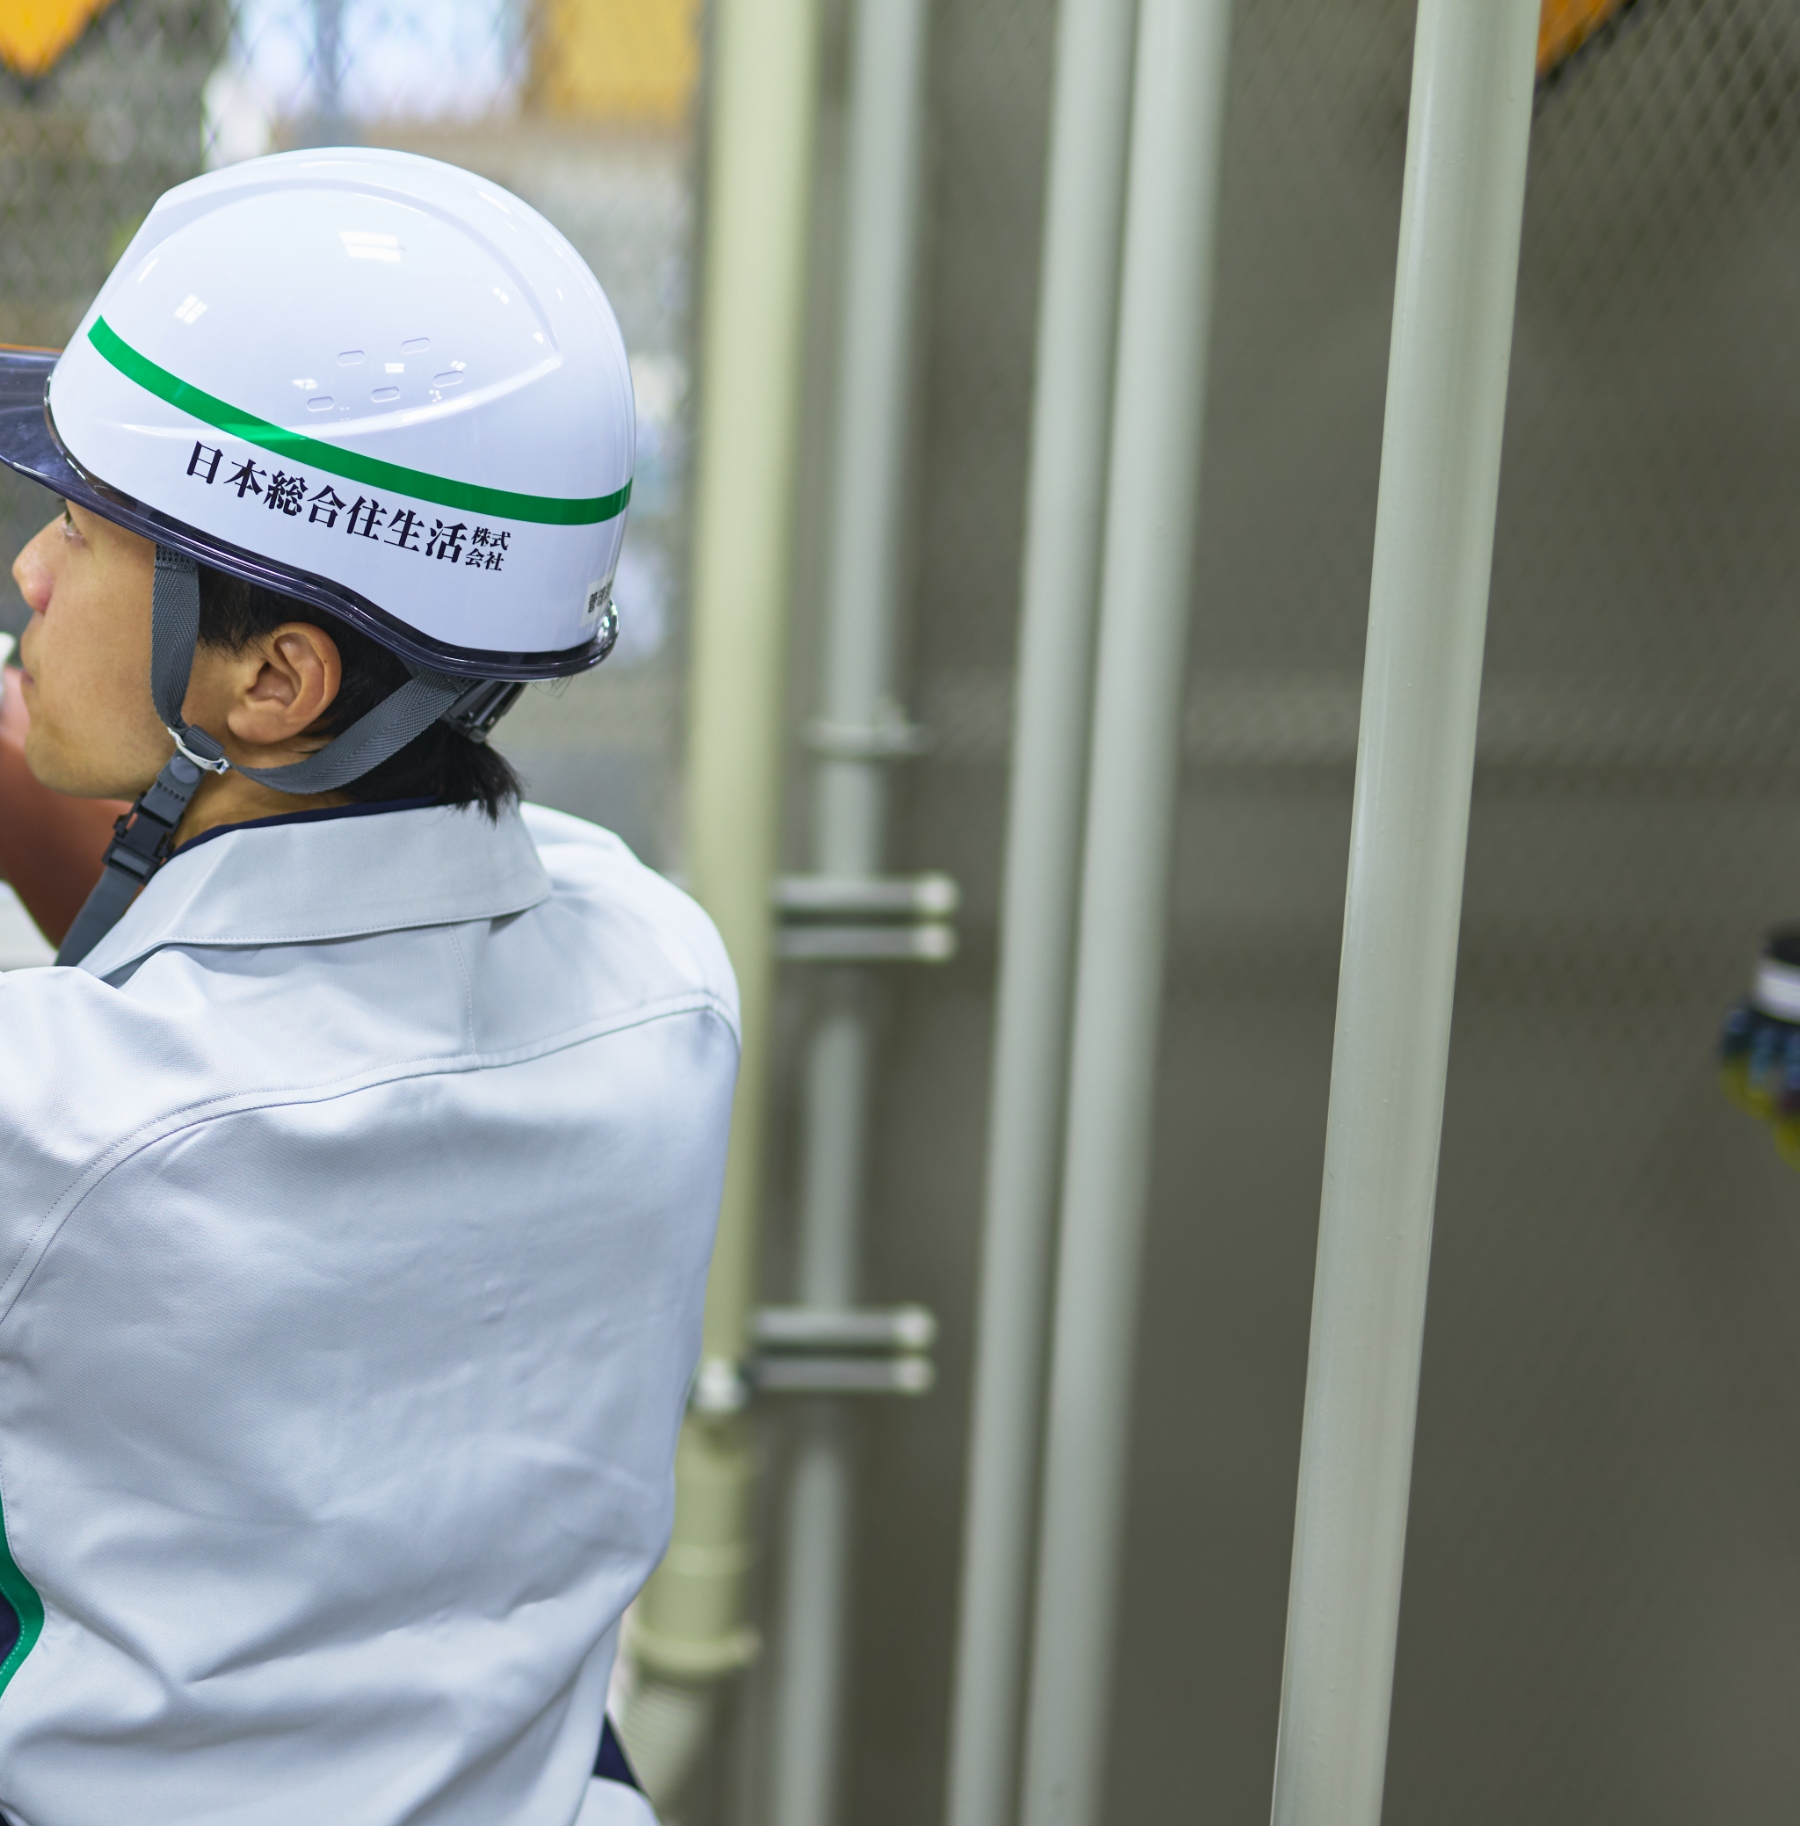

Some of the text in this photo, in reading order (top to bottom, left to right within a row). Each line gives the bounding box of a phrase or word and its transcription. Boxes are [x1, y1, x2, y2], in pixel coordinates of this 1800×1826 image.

[186, 440, 468, 563] 日本総合住生活
[470, 526, 512, 551] 株式
[464, 547, 505, 571] 会社
